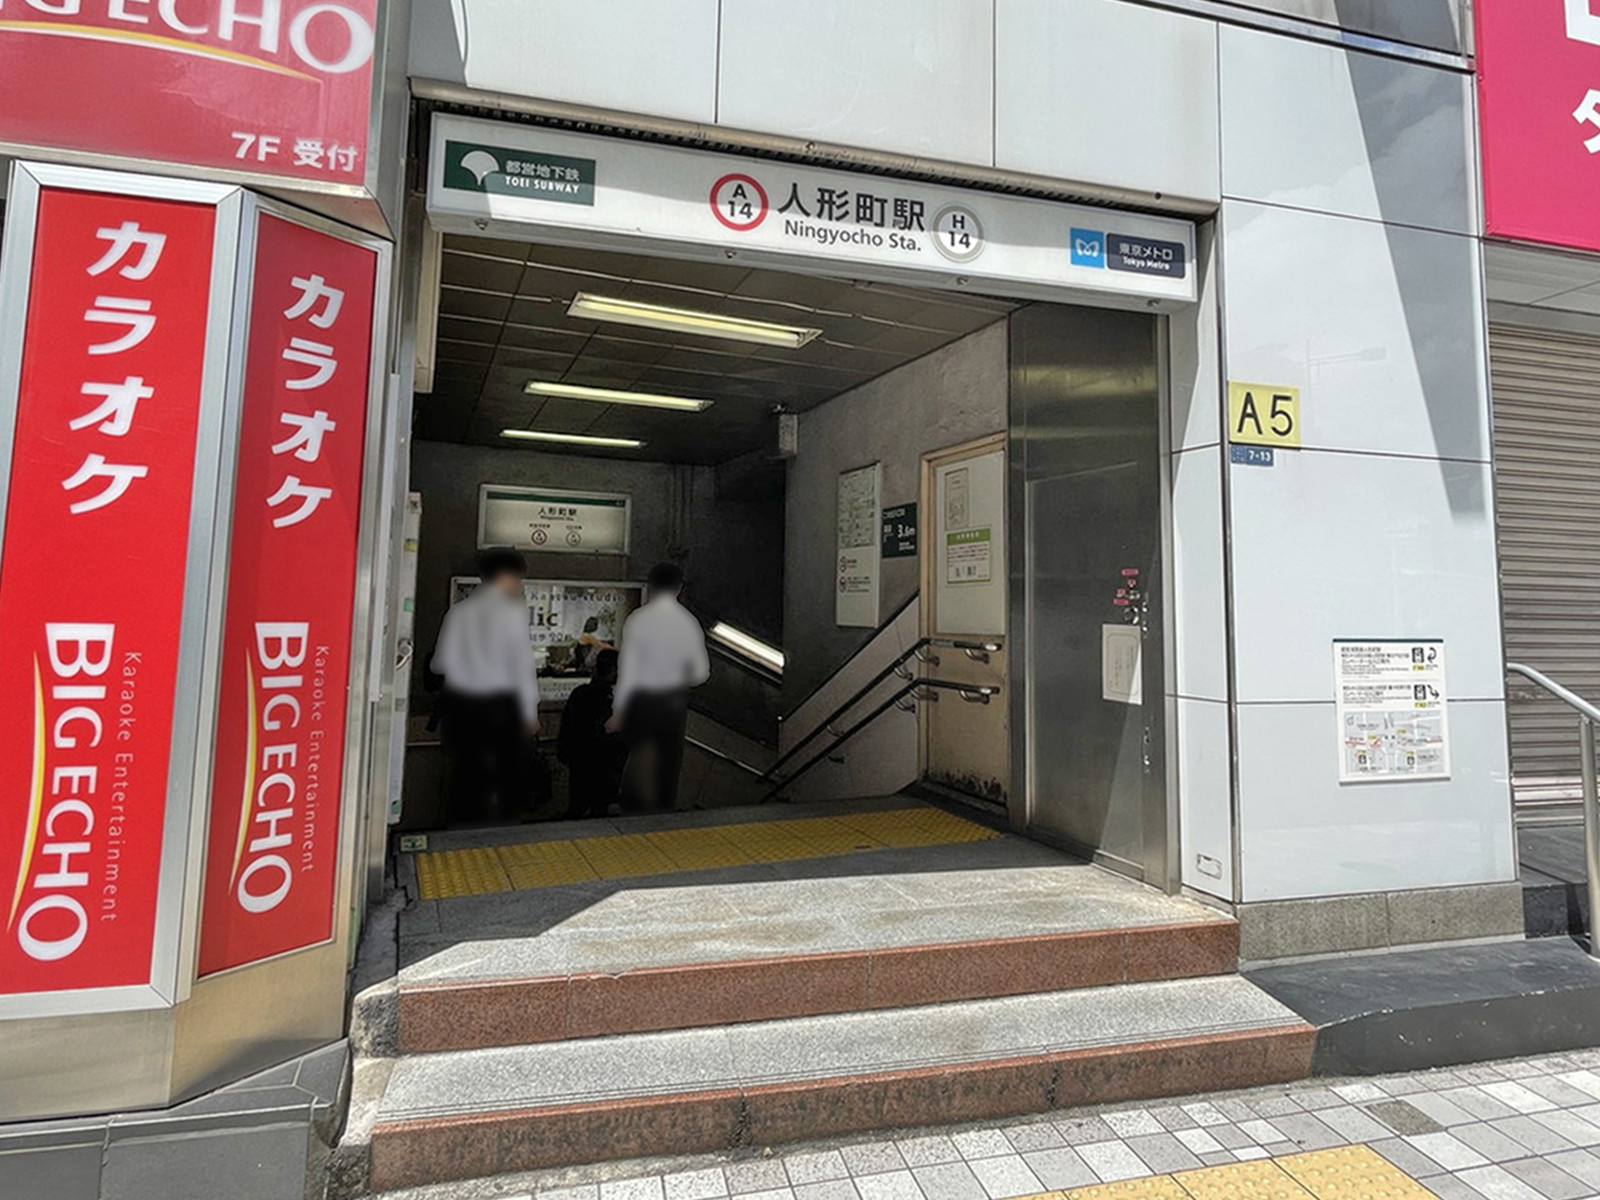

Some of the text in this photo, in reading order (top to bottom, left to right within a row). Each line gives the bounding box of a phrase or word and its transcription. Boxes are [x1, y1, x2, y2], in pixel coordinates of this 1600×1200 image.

[231, 131, 358, 173] 7F 受付
[504, 176, 580, 194] TOEI SUBWAY
[505, 160, 580, 182] 都営地下鉄
[727, 200, 753, 219] 14
[732, 183, 747, 199] A
[777, 182, 926, 232] 人形町駅
[784, 219, 922, 252] Ningyocho Sta.
[948, 231, 971, 249] 14
[952, 215, 965, 229] H
[1119, 242, 1173, 260] 東京メトロ
[1122, 256, 1170, 270] Tokyo Metro
[61, 221, 167, 515] カラオケ
[266, 274, 345, 529] カラオケ
[1237, 391, 1293, 437] A5
[237, 622, 310, 913] BIG ECHO
[300, 645, 330, 873] Karaoke Entertainment
[17, 622, 116, 962] BIG ECHO
[100, 651, 142, 922] Karaoke Entertainment
